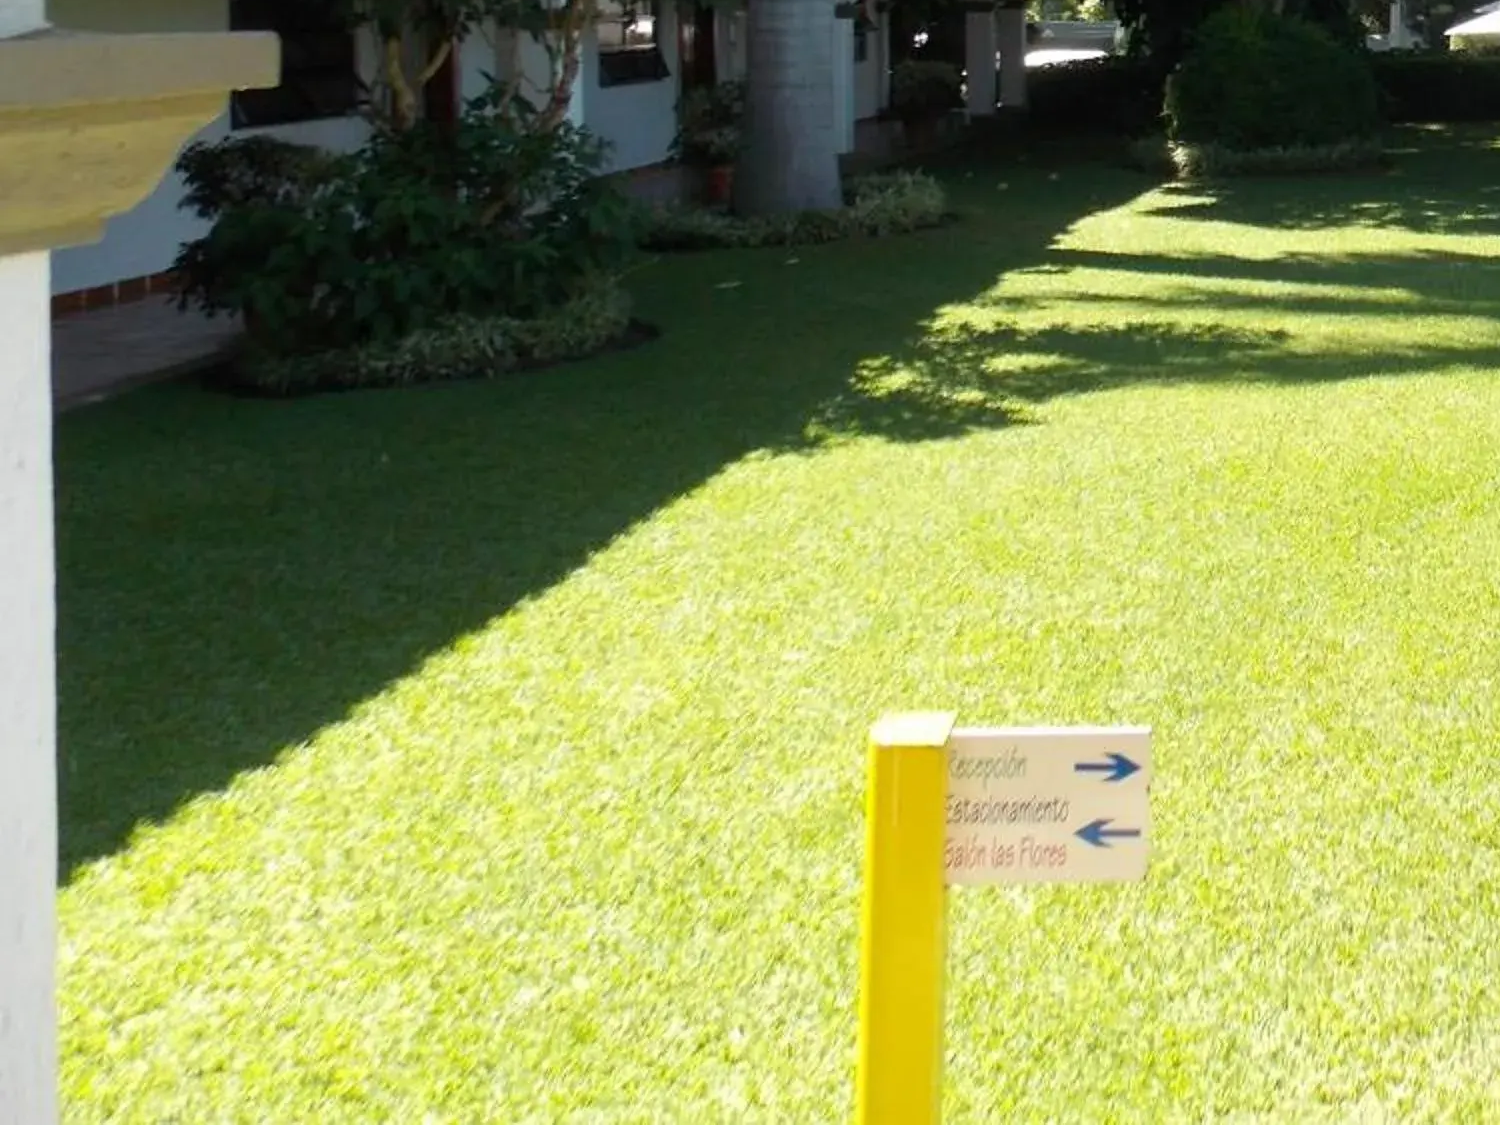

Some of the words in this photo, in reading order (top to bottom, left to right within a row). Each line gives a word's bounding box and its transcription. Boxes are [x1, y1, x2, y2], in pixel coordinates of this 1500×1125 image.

[945, 794, 1071, 825] Estacionamiento
[991, 836, 1014, 869] las
[1020, 835, 1067, 868] Flores
